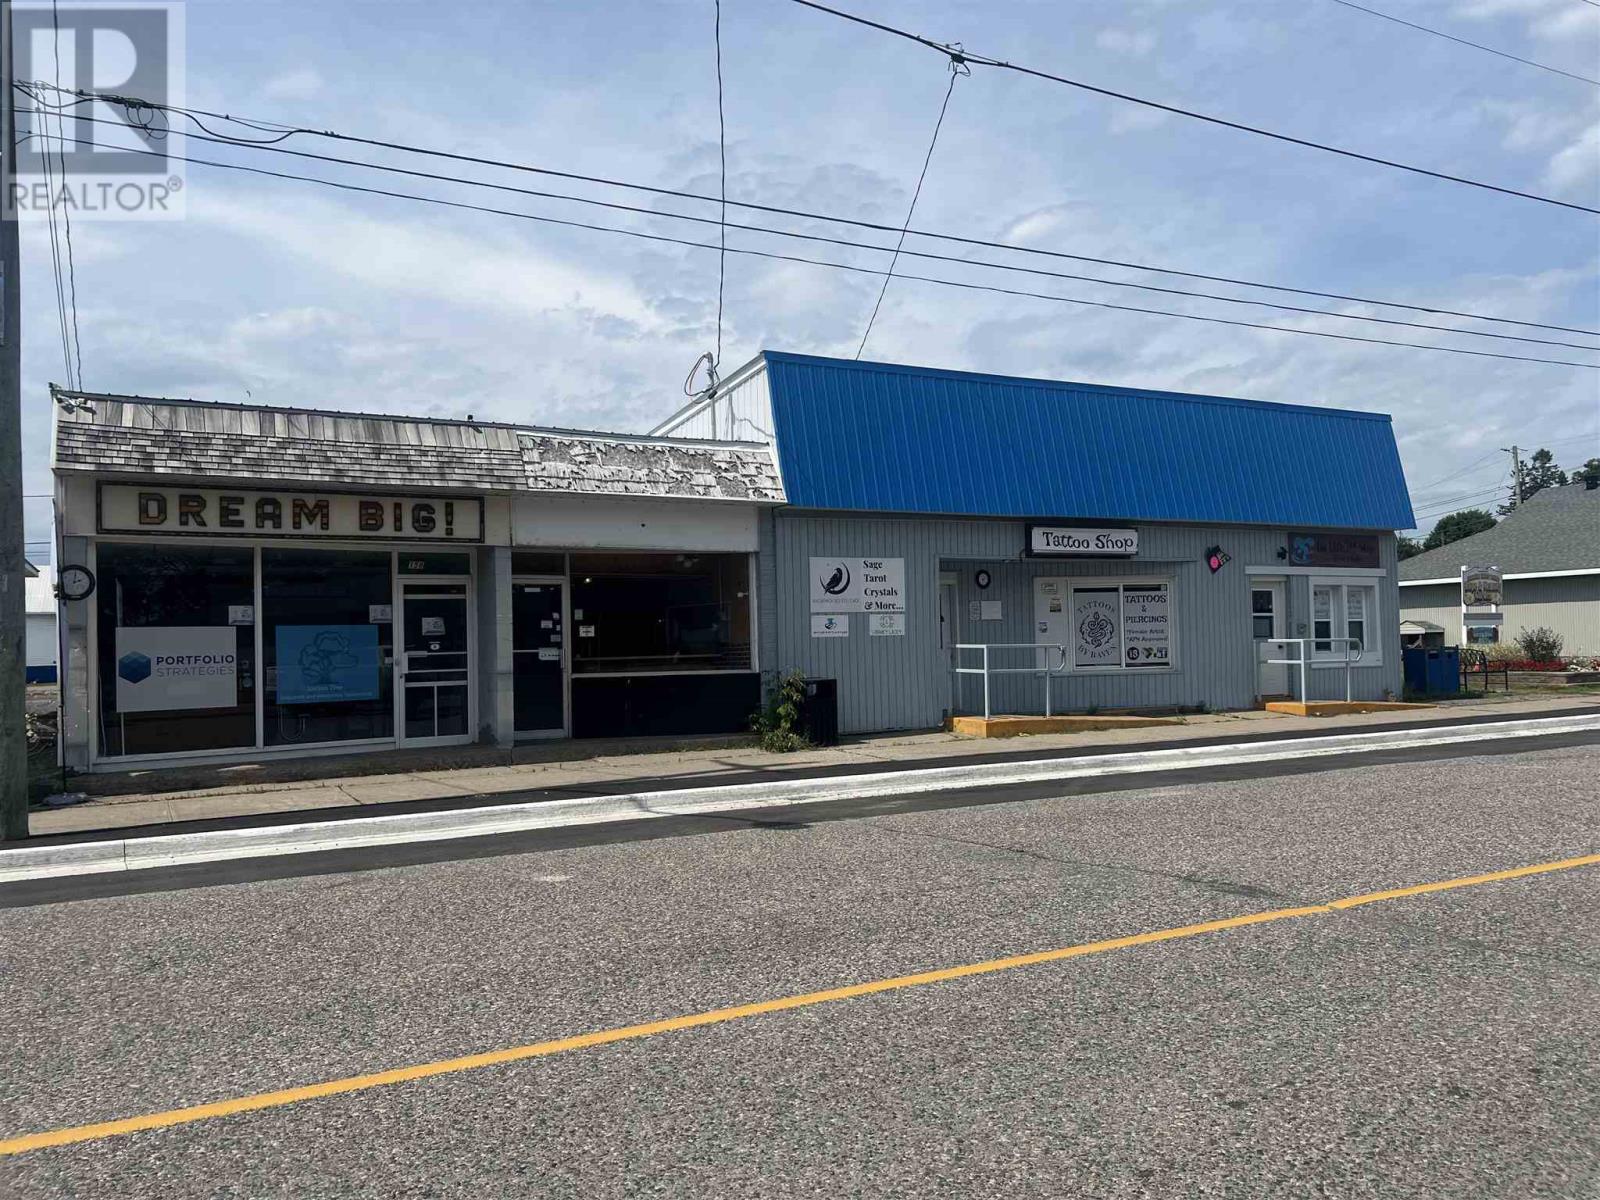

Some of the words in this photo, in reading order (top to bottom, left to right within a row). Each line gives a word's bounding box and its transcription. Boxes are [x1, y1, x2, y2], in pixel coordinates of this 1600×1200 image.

[138, 491, 330, 532] DREAM
[358, 500, 455, 536] BIG!
[1042, 531, 1090, 549] Tattoo
[1095, 533, 1134, 552] Shop
[863, 559, 883, 570] Sage
[863, 573, 887, 583] Tarot
[864, 587, 898, 598] Crystals
[1124, 594, 1167, 604] TATTOOS
[864, 602, 873, 610] &
[1077, 600, 1115, 614] TATTOOS
[1141, 605, 1148, 613] &
[1125, 615, 1168, 624] PIERCINGS
[156, 653, 235, 666] PORTFOLIO
[156, 666, 235, 678] STRATEGIES
